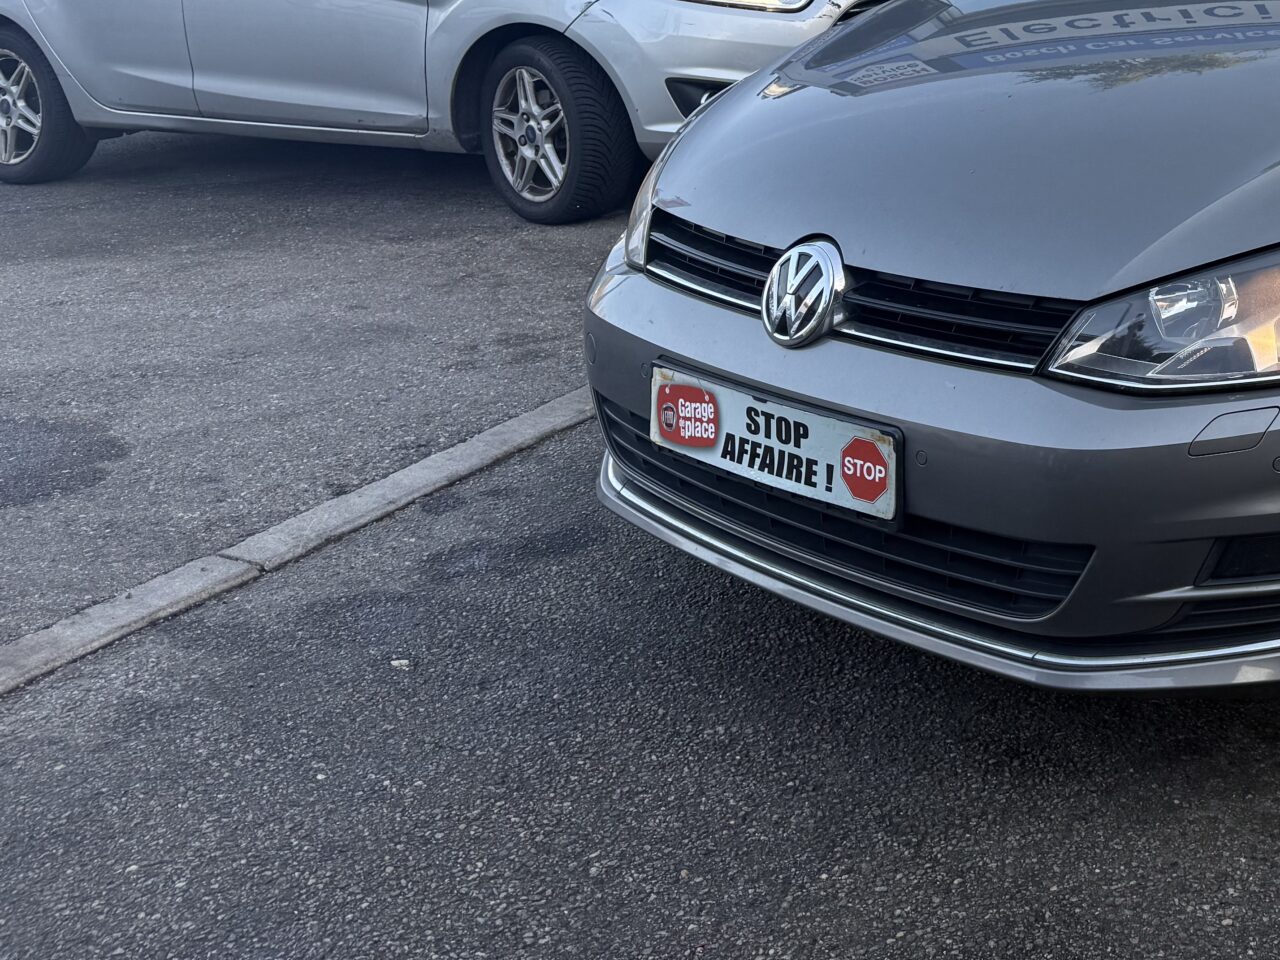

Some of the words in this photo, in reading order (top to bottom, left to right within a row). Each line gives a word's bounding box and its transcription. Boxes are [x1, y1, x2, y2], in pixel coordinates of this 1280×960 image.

[678, 398, 714, 420] Garage
[685, 420, 715, 439] place
[745, 406, 809, 449] STOP
[720, 433, 818, 488] AFFAIRE
[824, 463, 834, 493] !
[844, 456, 886, 482] STOP
